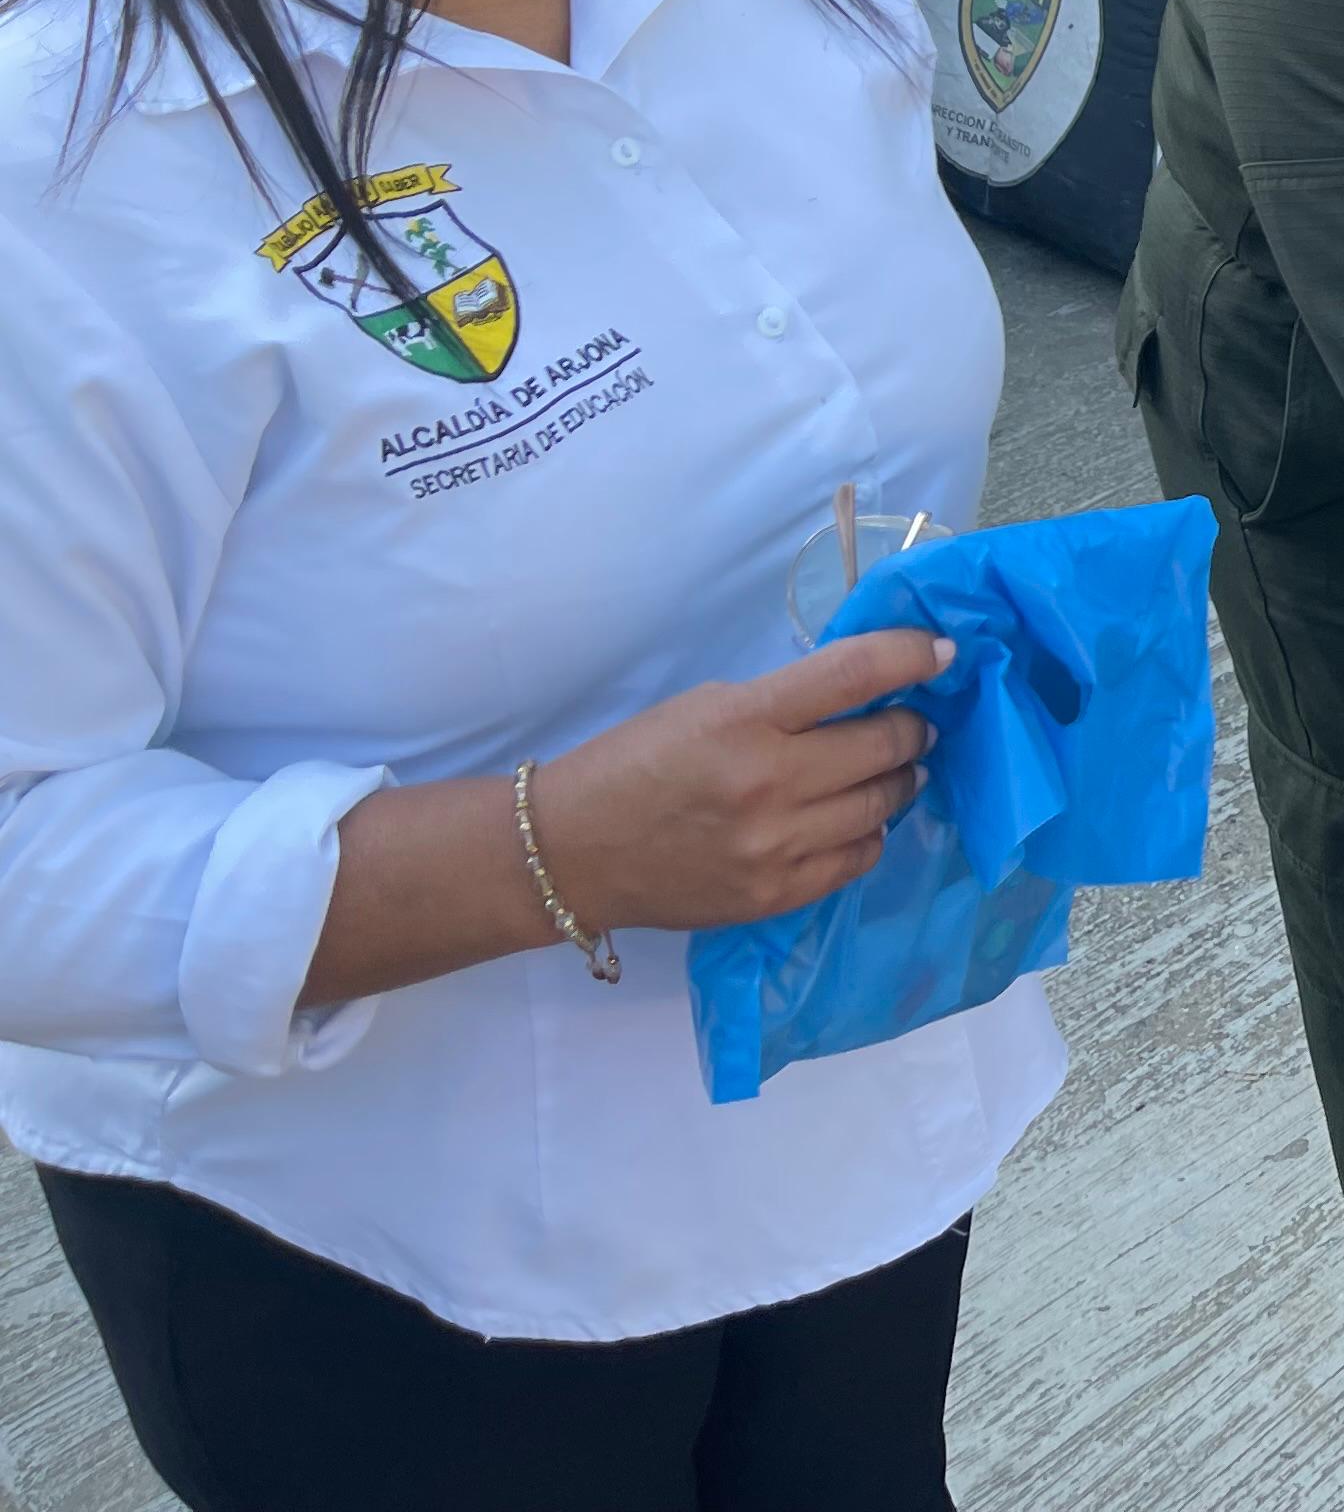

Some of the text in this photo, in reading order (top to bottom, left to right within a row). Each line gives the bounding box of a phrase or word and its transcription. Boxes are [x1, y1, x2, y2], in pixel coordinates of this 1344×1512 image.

[380, 328, 631, 463] ALCALDÍA DE ARJONA
[410, 440, 540, 500] SECRETARIA
[534, 423, 565, 453] DE
